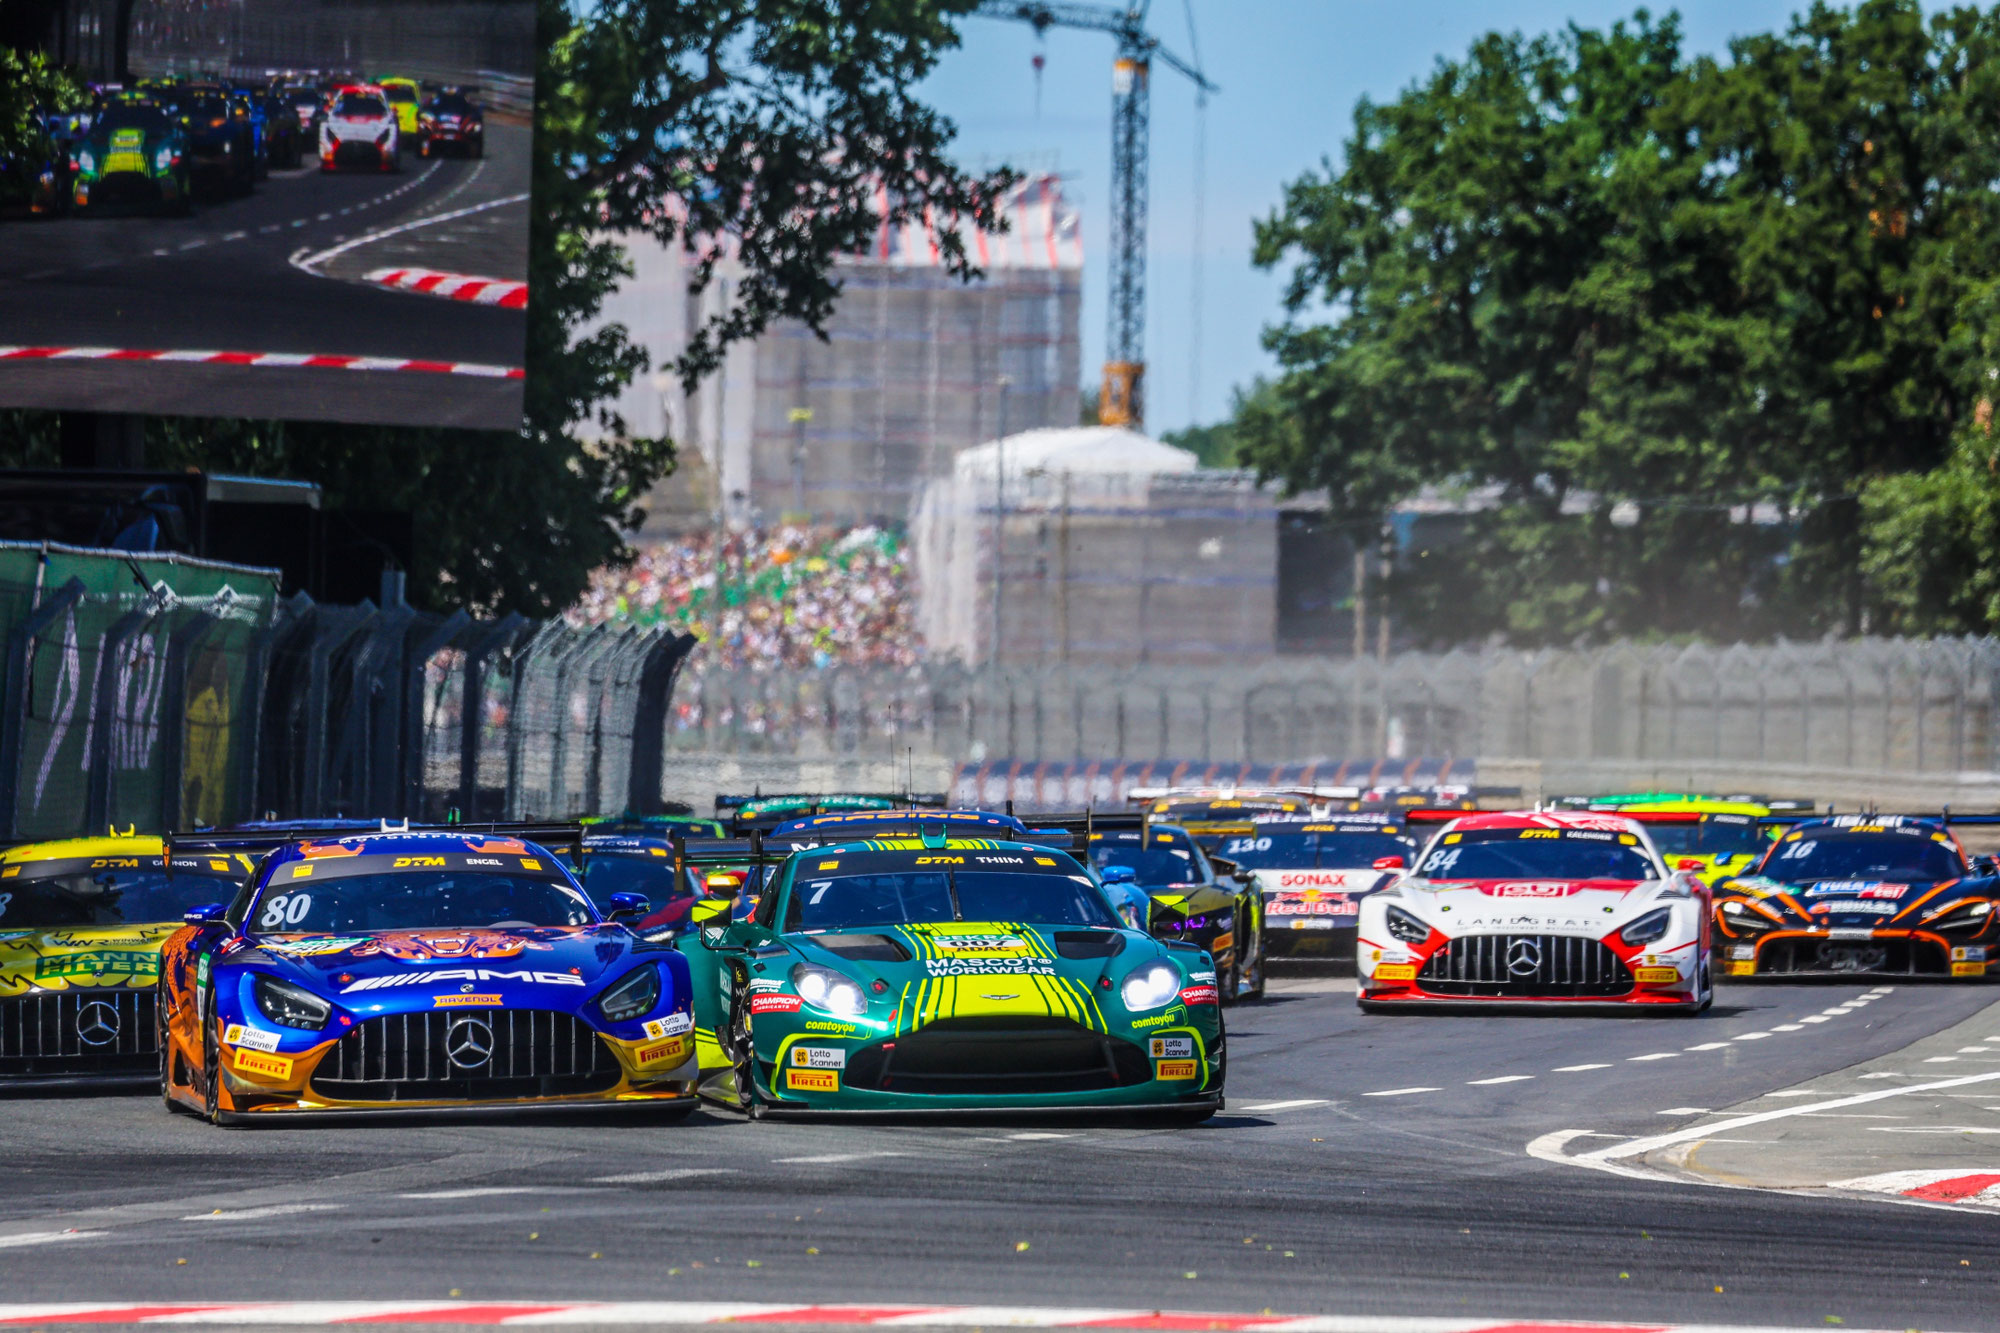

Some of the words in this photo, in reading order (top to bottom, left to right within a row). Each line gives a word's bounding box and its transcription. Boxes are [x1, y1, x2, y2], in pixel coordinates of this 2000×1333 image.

[1519, 829, 1560, 839] DTM
[1228, 837, 1272, 854] 130
[1780, 840, 1818, 860] 16
[91, 858, 139, 868] DTM
[393, 856, 446, 868] DTM
[466, 858, 503, 866] ENGEL
[915, 856, 965, 865] DTM
[975, 856, 1024, 865] THIIM
[1423, 848, 1463, 872] 84
[1281, 873, 1346, 887] SONAX
[809, 881, 833, 905] 7
[261, 893, 312, 928] 80
[1264, 901, 1311, 915] Red
[1311, 901, 1359, 916] Bull
[43, 952, 158, 967] MANN
[41, 961, 157, 976] FILTER
[927, 966, 1058, 977] WORKWEAR
[752, 997, 801, 1006] CHAMPION
[660, 1016, 680, 1027] Lotto
[805, 1021, 856, 1033] comtoyou
[1131, 1014, 1175, 1029] comtoyou
[243, 1028, 266, 1039] Lotto
[663, 1023, 690, 1034] Scanner
[240, 1037, 274, 1050] Scanner
[1165, 1040, 1182, 1048] Lotto
[640, 1041, 681, 1063] PIRELLI
[809, 1049, 831, 1058] Lotto
[1165, 1048, 1190, 1056] Scanner
[239, 1053, 287, 1075] PIRELLI
[809, 1058, 842, 1067] Scanner
[1160, 1063, 1193, 1076] PIRELLI
[791, 1073, 833, 1087] PIRELLI
